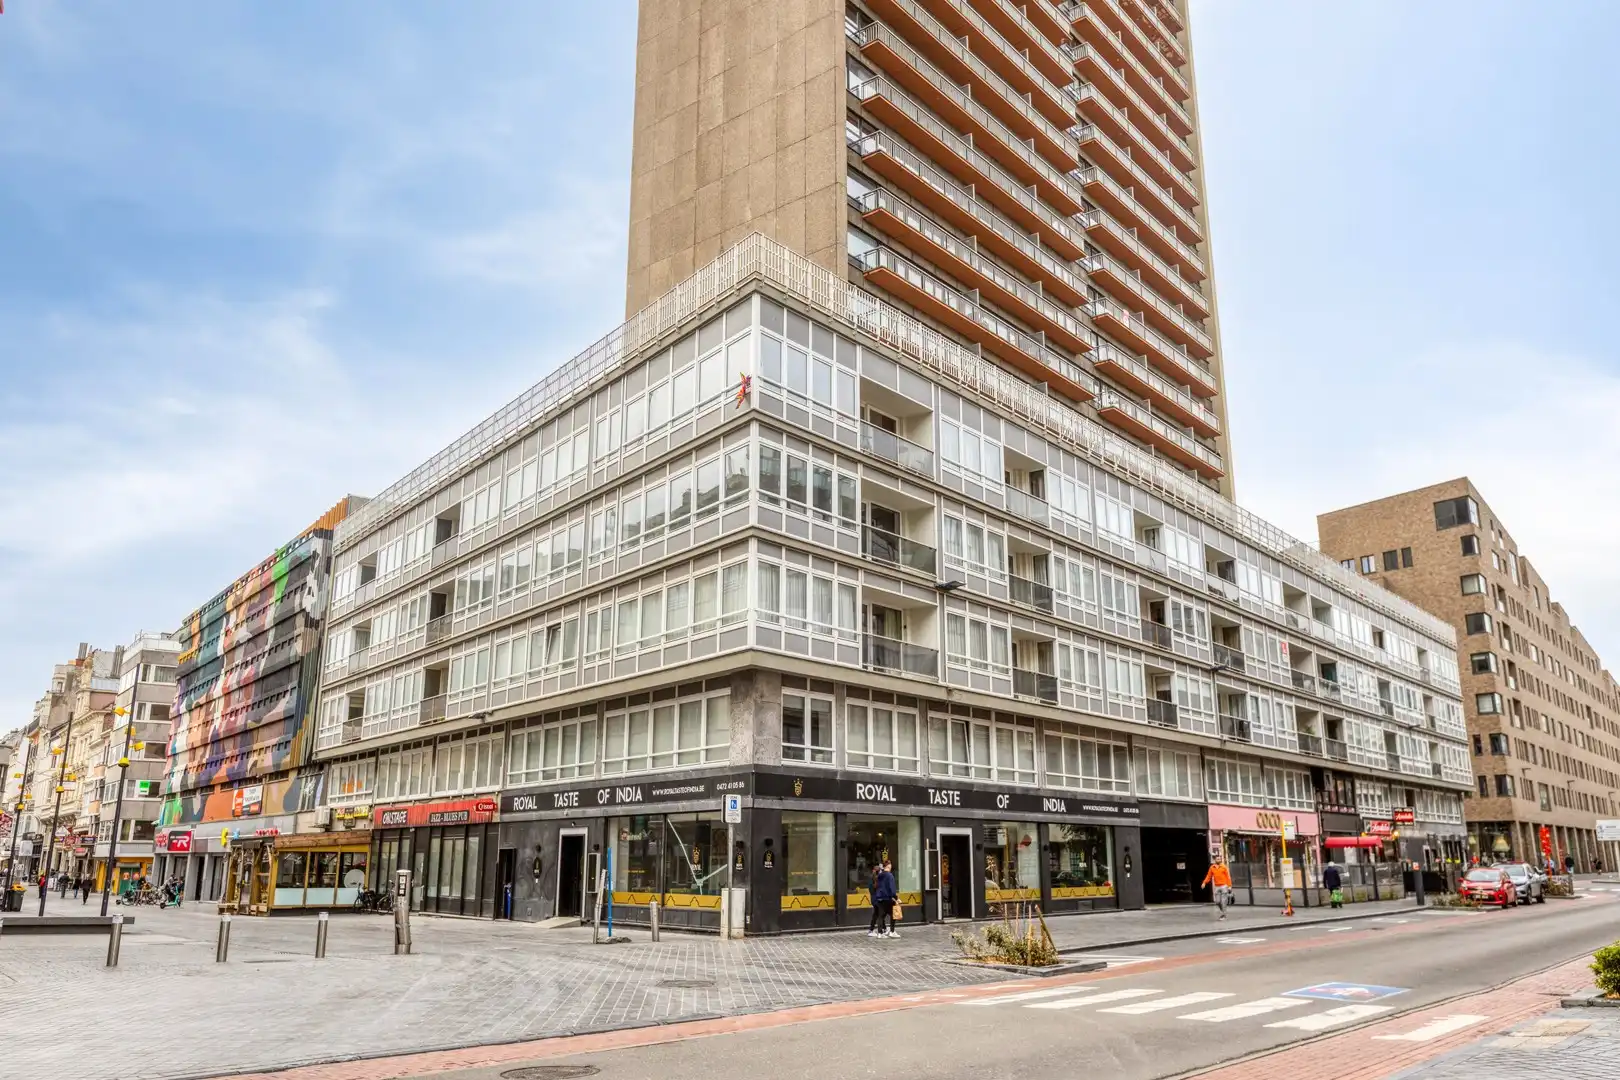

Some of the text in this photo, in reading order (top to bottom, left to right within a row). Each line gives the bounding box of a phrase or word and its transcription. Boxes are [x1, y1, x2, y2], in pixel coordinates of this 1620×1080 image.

[513, 786, 643, 811] ROYAL TASTE OF INDIA
[856, 783, 897, 802] ROYAL
[928, 789, 961, 806] TASTE
[996, 794, 1009, 809] OF
[1043, 798, 1067, 813] INDIA
